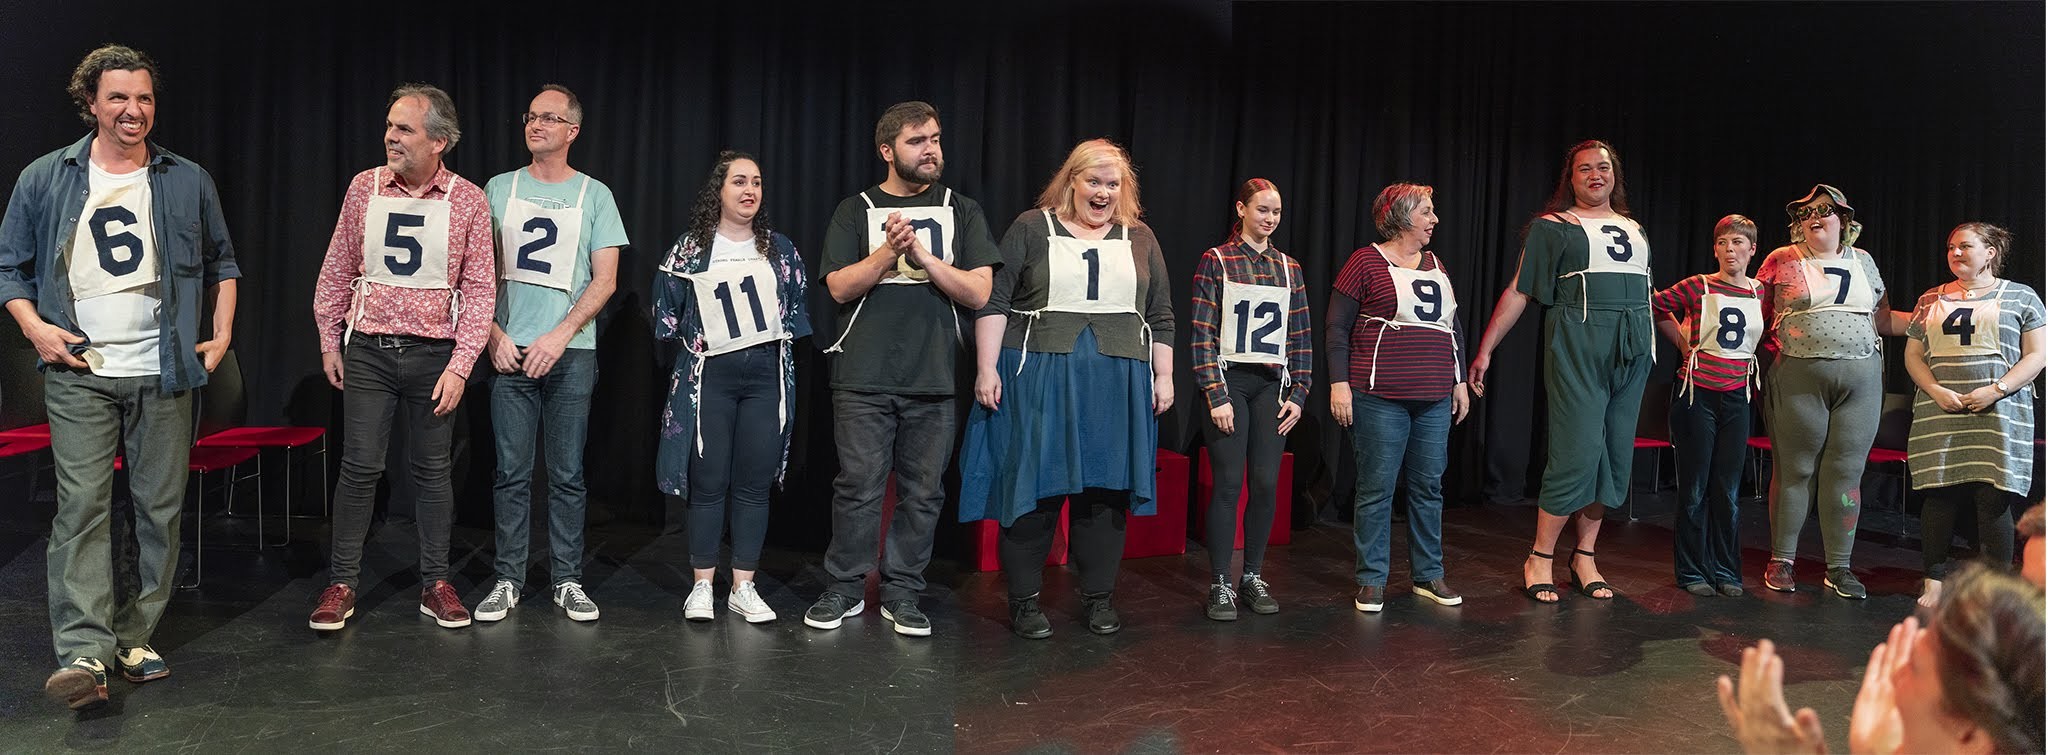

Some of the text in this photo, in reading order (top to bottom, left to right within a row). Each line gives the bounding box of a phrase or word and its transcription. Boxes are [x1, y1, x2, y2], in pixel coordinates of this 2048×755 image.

[88, 206, 144, 277] 6
[384, 213, 425, 276] 5
[517, 217, 558, 274] 2
[881, 218, 944, 270] 0
[1601, 225, 1632, 262] 3
[1082, 249, 1099, 300] 1
[1823, 267, 1851, 304] 7
[714, 275, 767, 339] 11
[1412, 279, 1442, 322] 9
[1234, 300, 1282, 355] 12
[1716, 307, 1746, 349] 8
[1942, 308, 1975, 346] 4
